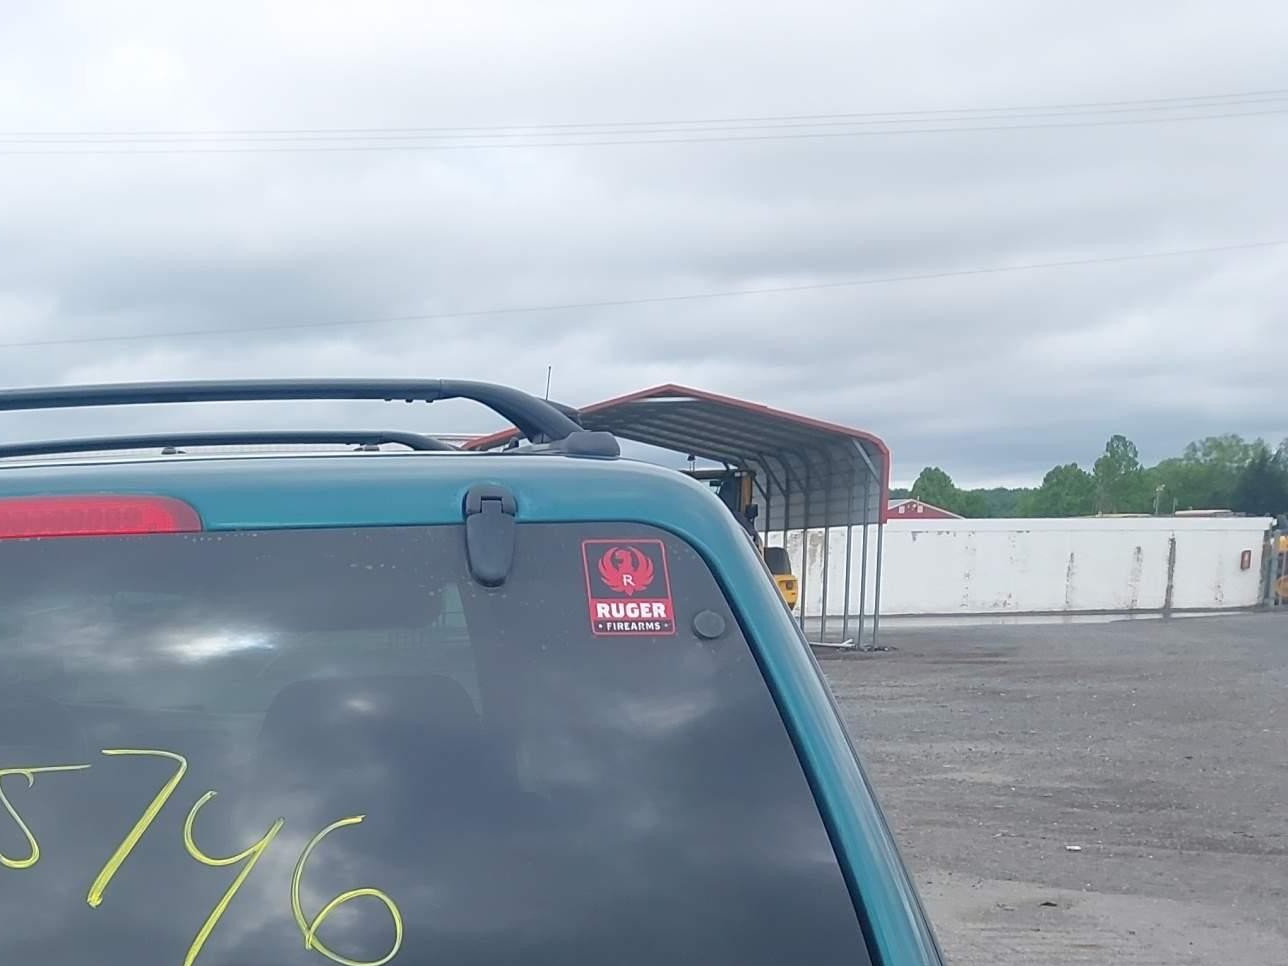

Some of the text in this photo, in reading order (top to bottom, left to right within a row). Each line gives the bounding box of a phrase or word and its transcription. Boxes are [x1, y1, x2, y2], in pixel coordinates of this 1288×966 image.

[623, 574, 635, 586] R
[596, 602, 666, 618] RUGER
[606, 622, 661, 631] FIREARMS
